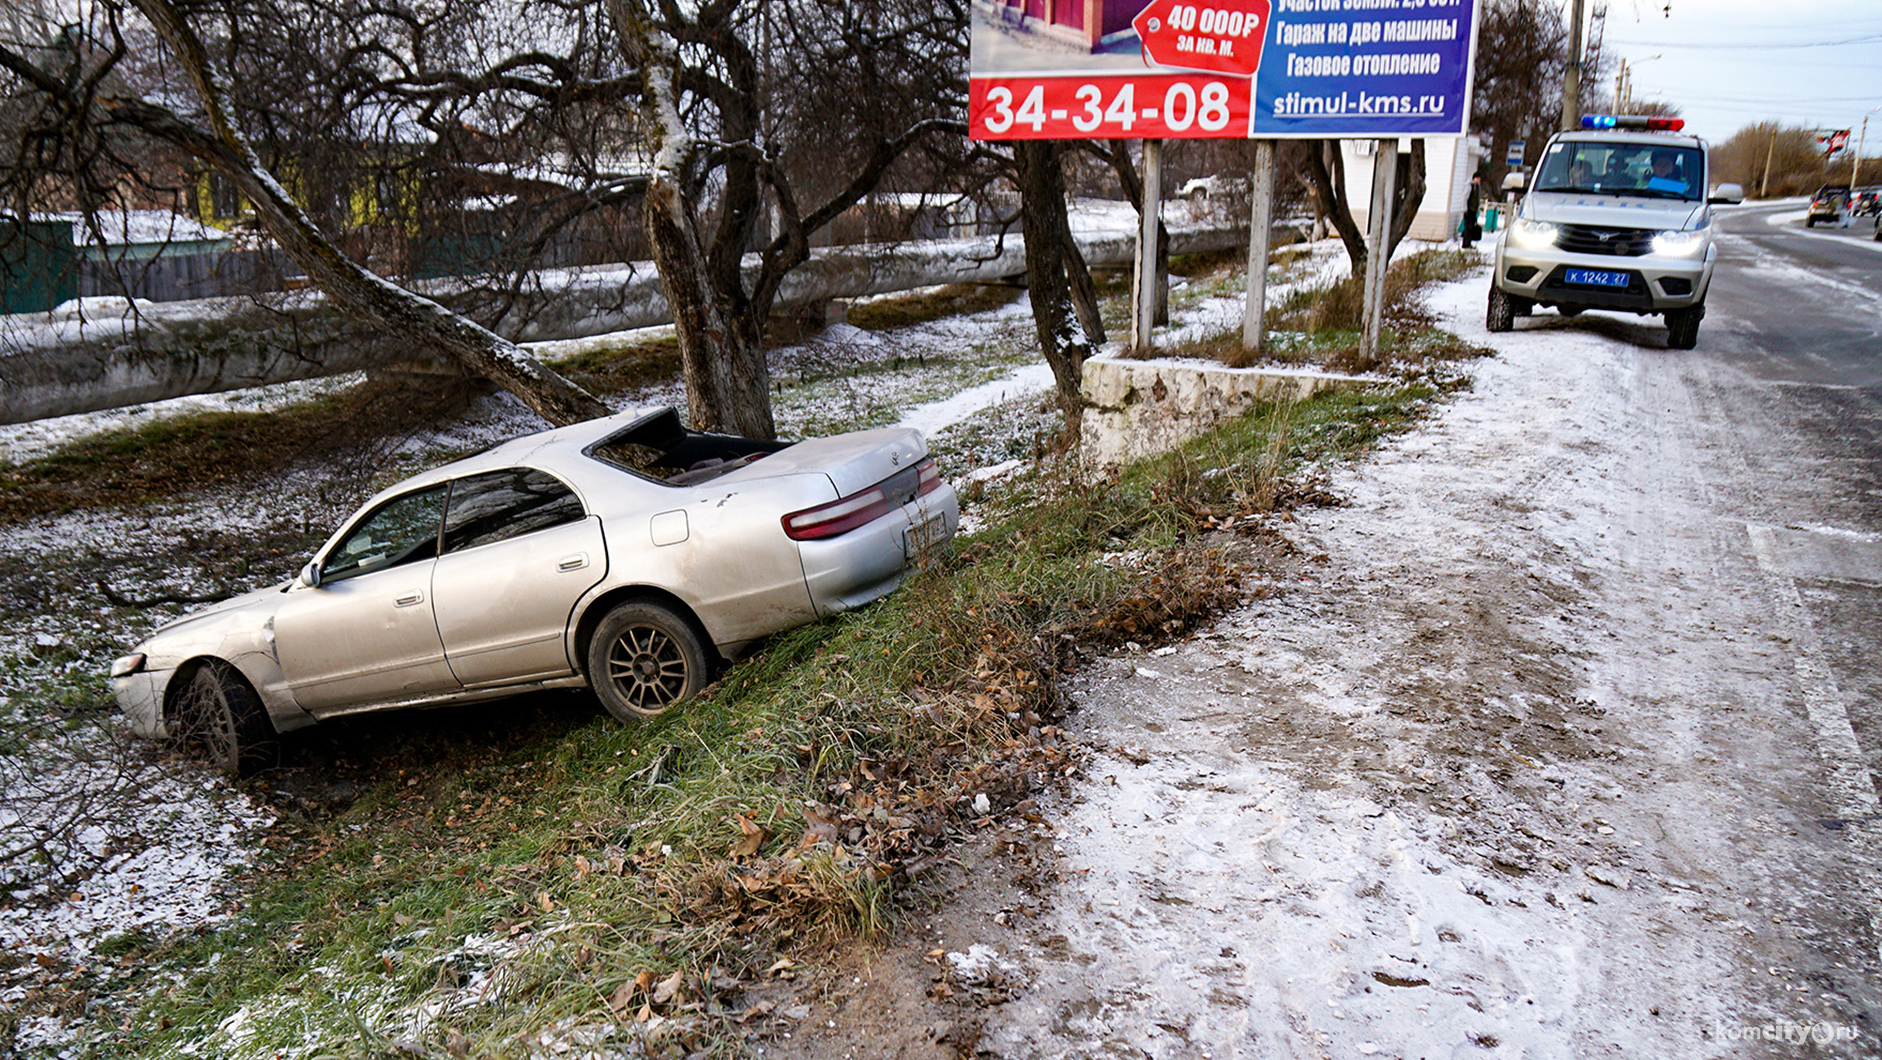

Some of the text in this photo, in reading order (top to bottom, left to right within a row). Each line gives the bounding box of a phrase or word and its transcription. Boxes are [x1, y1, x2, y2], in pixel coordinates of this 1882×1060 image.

[1167, 5, 1197, 31] 40
[1276, 19, 1458, 46] Гараж на две машины
[1176, 34, 1234, 57] ЗА КВ. М.
[1287, 52, 1441, 77] Газовое отопление
[984, 81, 1230, 133] 34-34-08
[1273, 91, 1445, 114] stimul-kms.ru
[1582, 271, 1609, 285] 1242
[1614, 272, 1626, 283] 27
